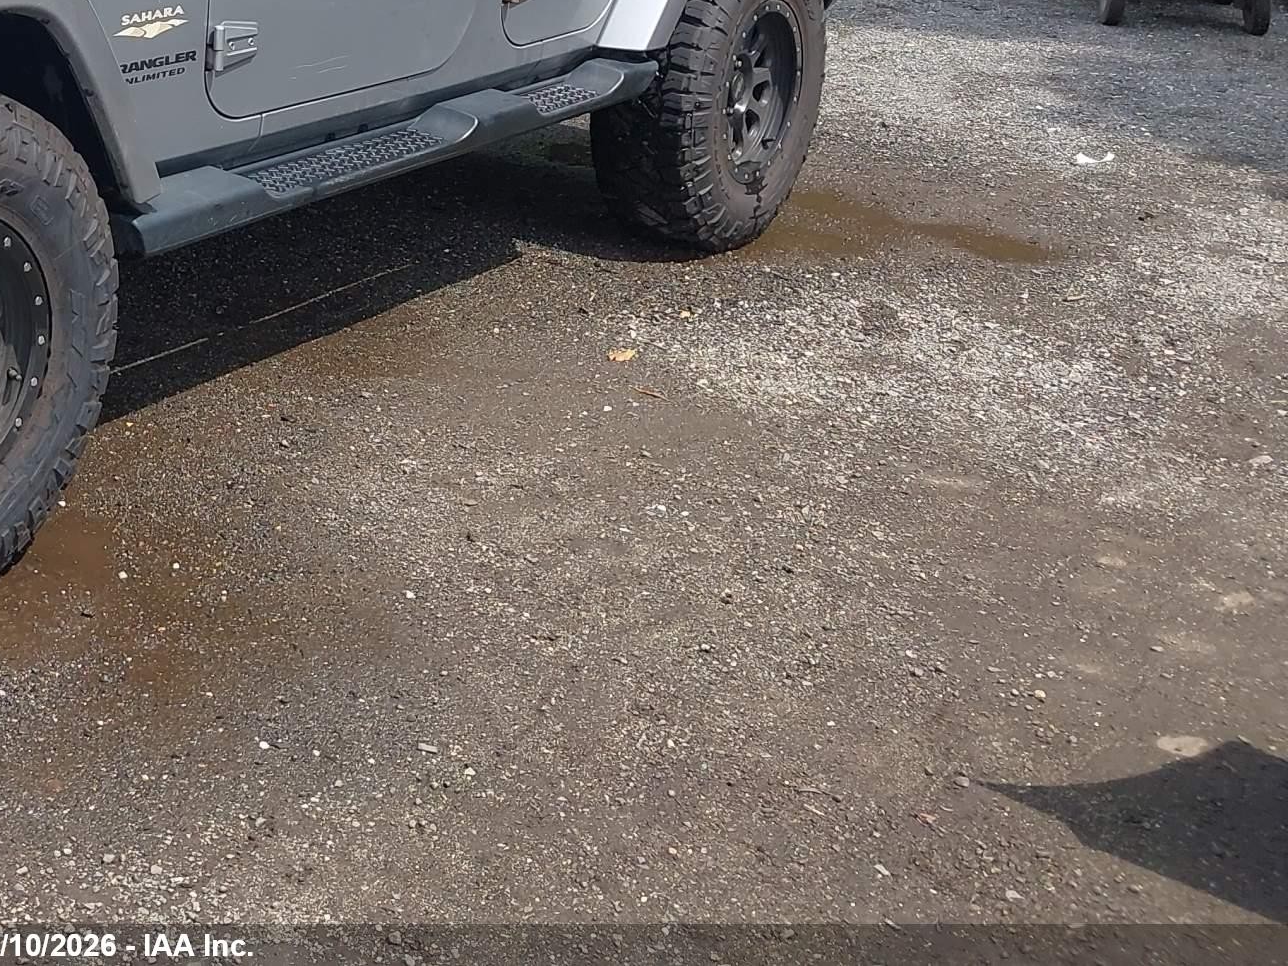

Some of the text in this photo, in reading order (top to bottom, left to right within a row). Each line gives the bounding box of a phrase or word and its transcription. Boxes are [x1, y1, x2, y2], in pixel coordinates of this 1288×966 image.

[121, 5, 185, 26] SAHARA
[120, 50, 197, 74] RANGLER
[125, 67, 186, 85] NLIMITED
